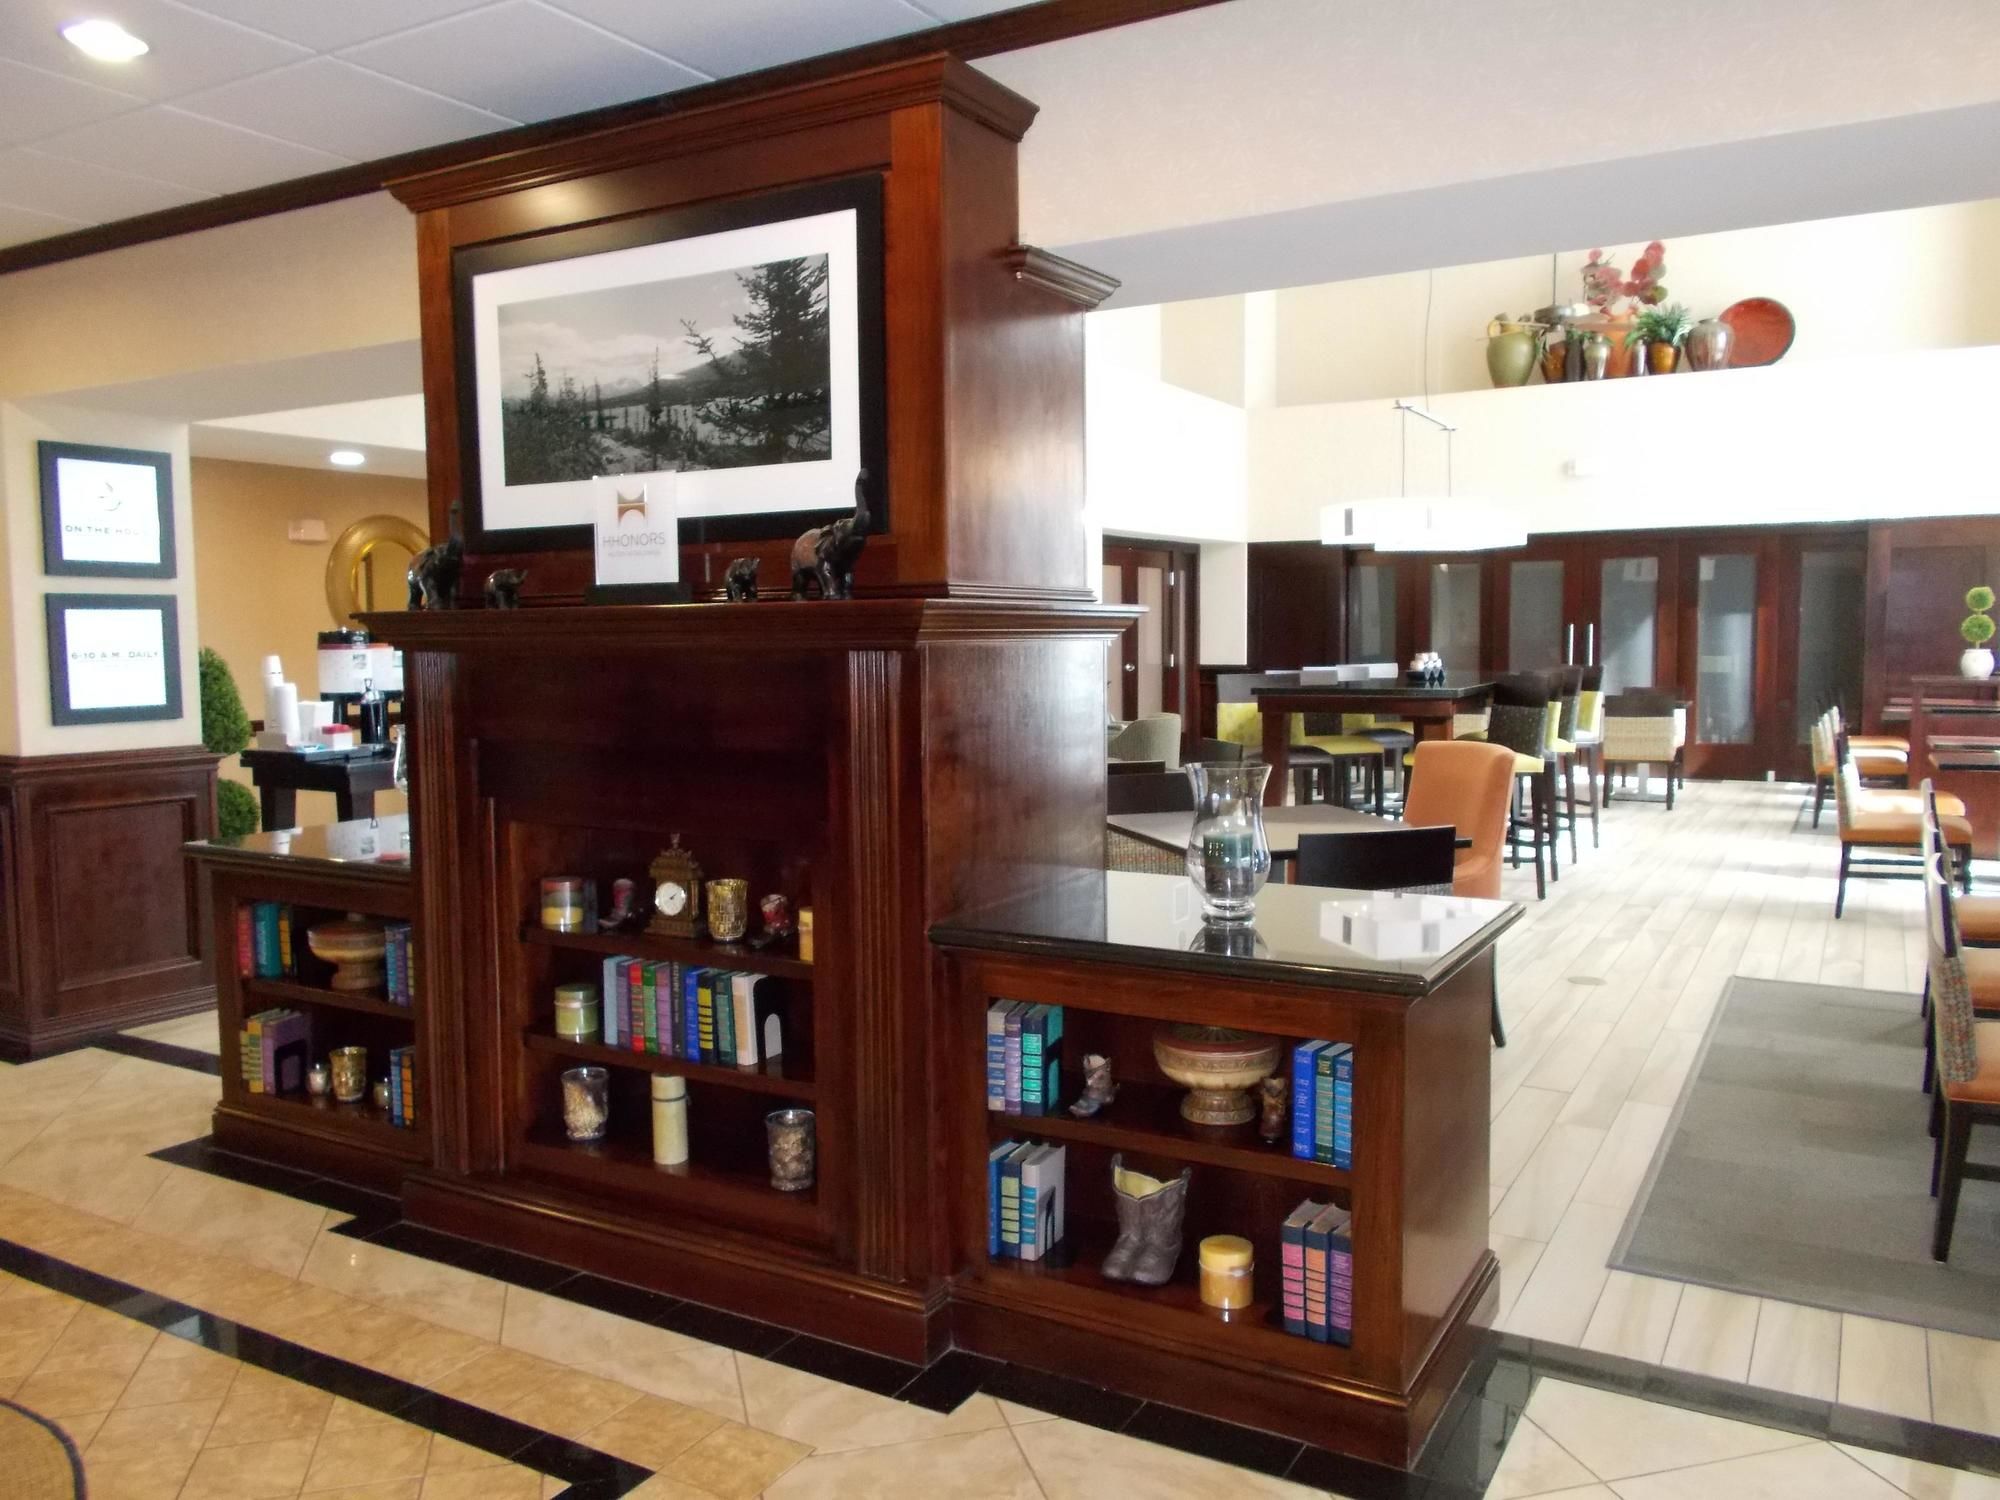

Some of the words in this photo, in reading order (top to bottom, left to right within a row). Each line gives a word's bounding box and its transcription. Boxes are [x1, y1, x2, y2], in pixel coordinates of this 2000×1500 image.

[64, 524, 83, 533] ON
[86, 525, 110, 535] THE
[602, 531, 666, 548] HHONORS
[71, 651, 96, 660] 6-10
